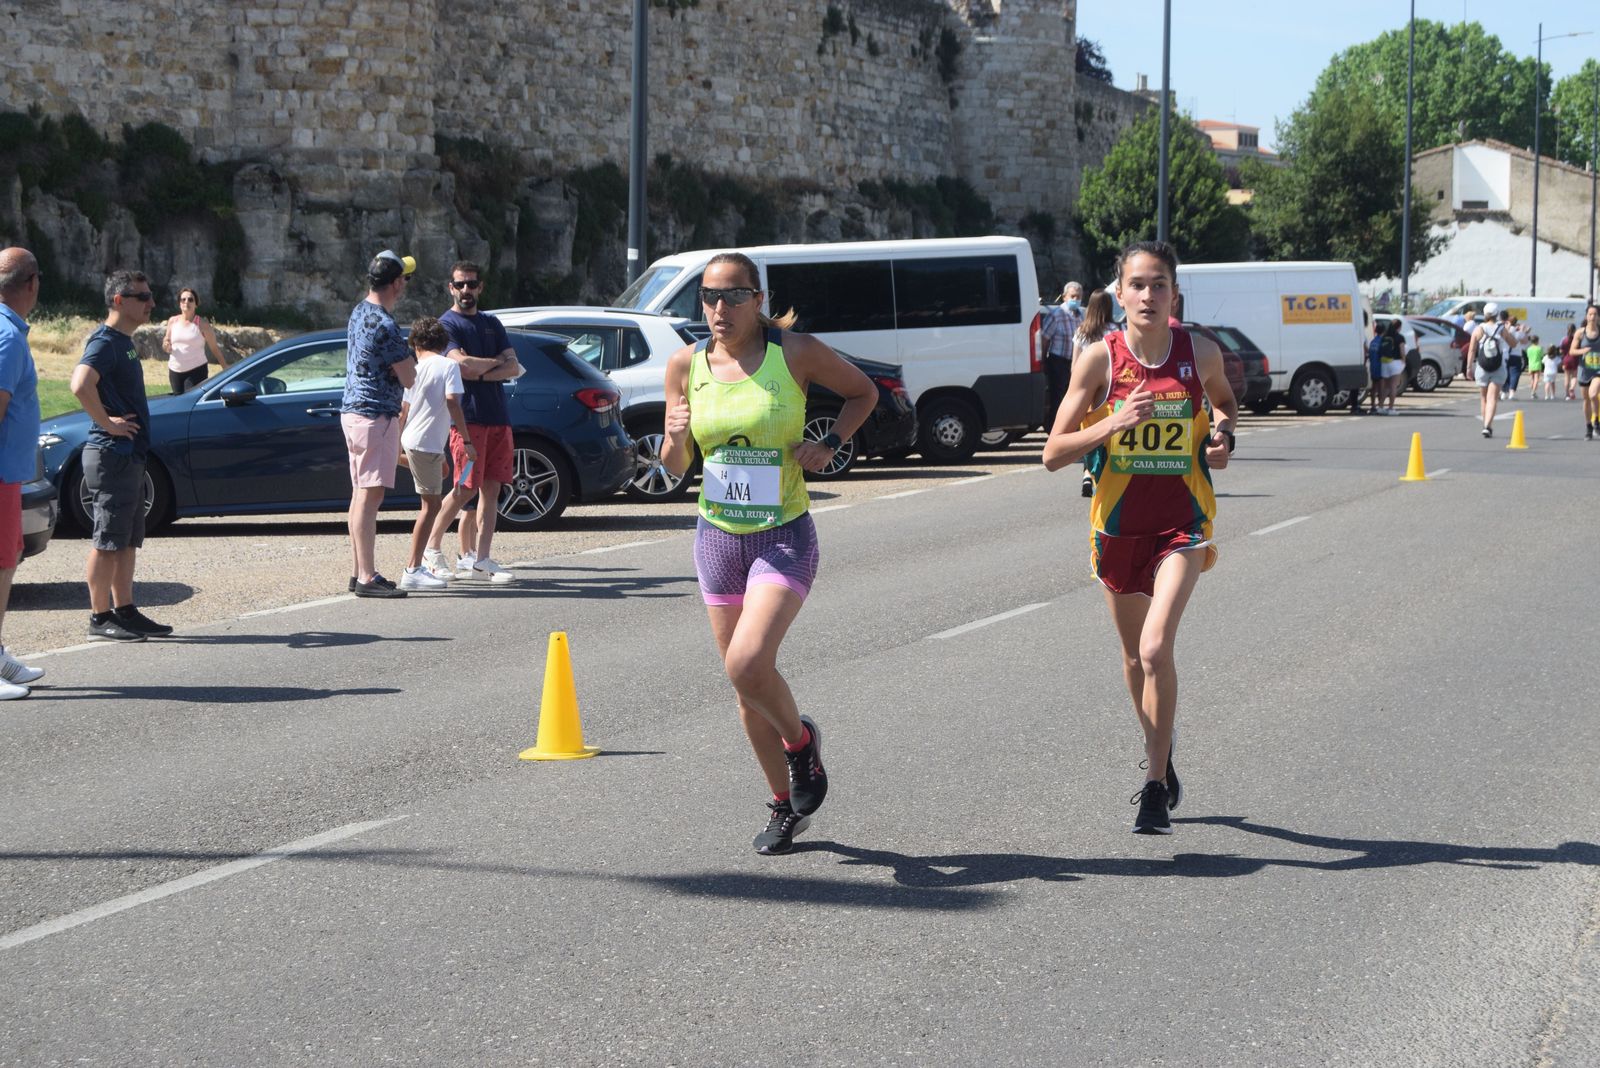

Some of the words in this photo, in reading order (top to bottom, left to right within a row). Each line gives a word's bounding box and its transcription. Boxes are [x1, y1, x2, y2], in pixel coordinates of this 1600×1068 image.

[1546, 308, 1577, 318] Hertz
[1166, 391, 1192, 400] RURAL
[1118, 423, 1184, 451] 402
[724, 449, 771, 458] FUNDACION
[745, 457, 771, 465] RURAL
[1133, 461, 1155, 469] CAJA
[1157, 461, 1187, 469] RURAL
[720, 470, 728, 480] 14
[724, 481, 752, 501] ANA
[723, 509, 744, 518] CAJA
[746, 510, 778, 520] RURAL
